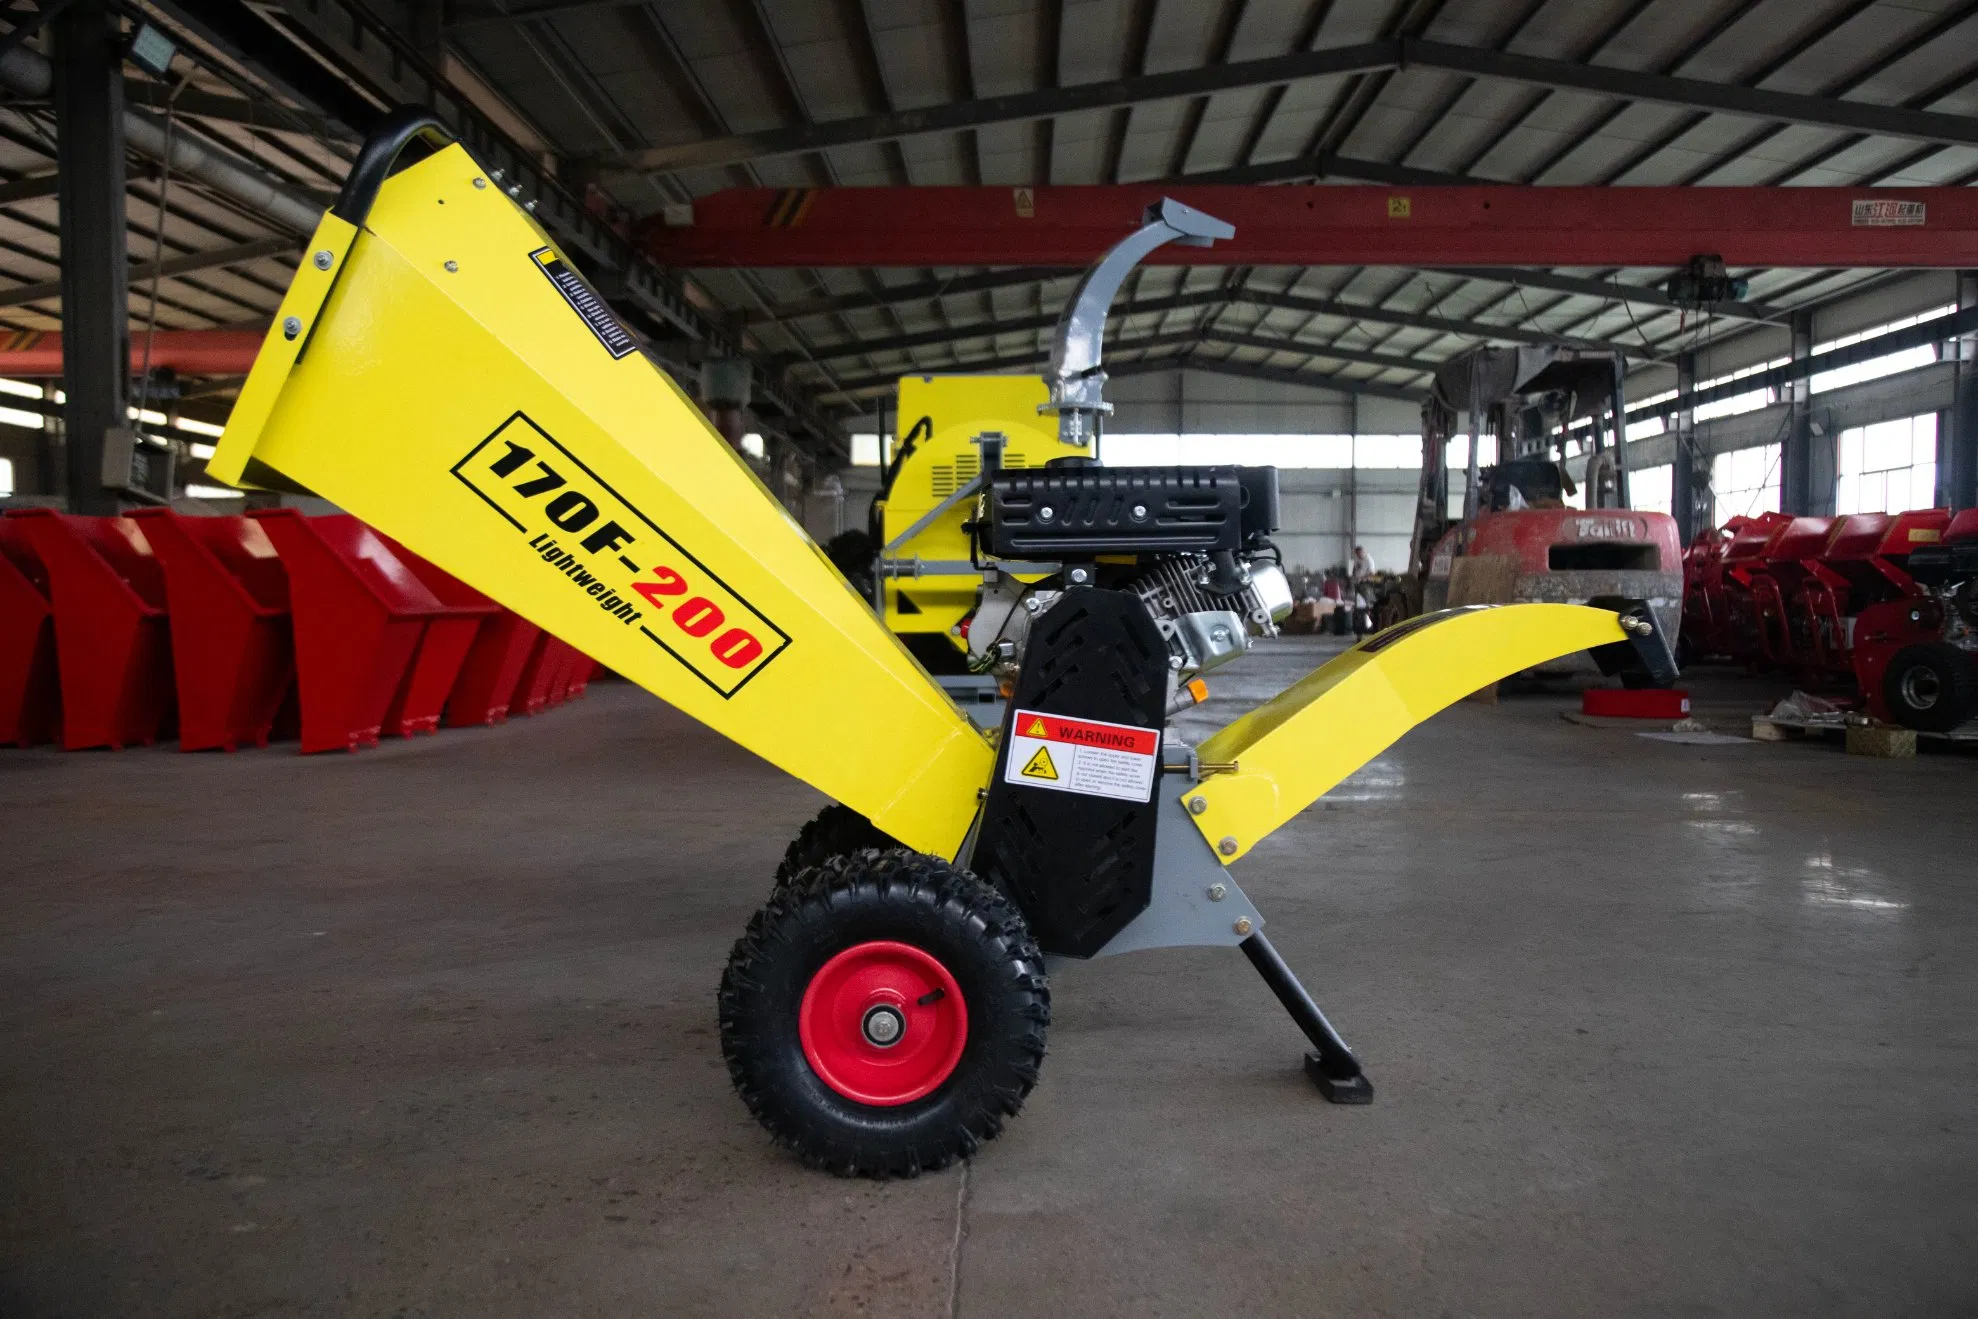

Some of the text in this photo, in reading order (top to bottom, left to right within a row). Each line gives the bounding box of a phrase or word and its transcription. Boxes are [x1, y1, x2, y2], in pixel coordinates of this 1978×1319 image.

[489, 440, 763, 669] 170F-200
[528, 533, 643, 626] Lightweight
[1059, 727, 1135, 748] WARNING
